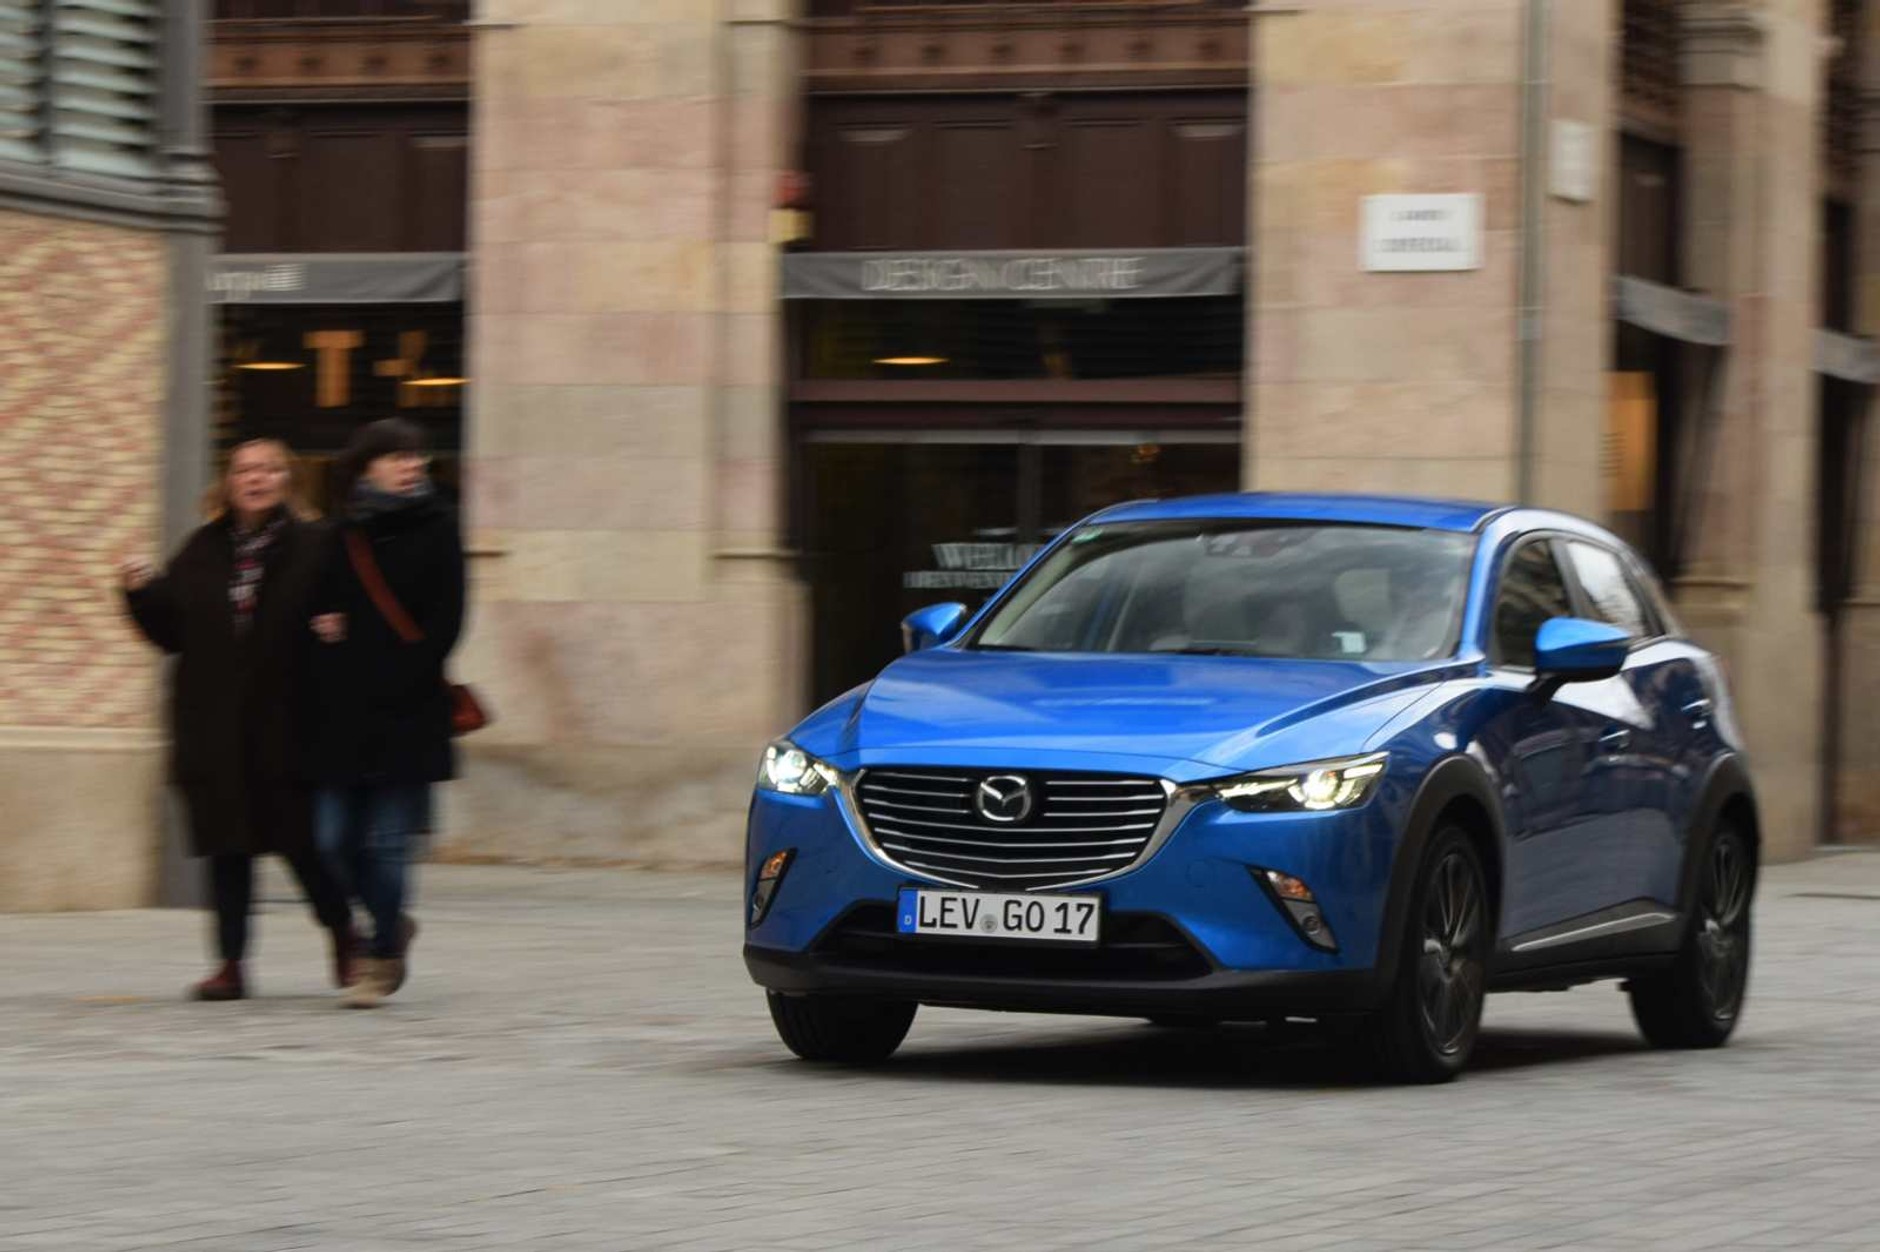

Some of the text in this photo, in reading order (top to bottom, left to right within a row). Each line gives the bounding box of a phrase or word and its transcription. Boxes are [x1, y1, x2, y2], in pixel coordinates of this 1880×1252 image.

[919, 896, 1095, 934] LEV GO 17
